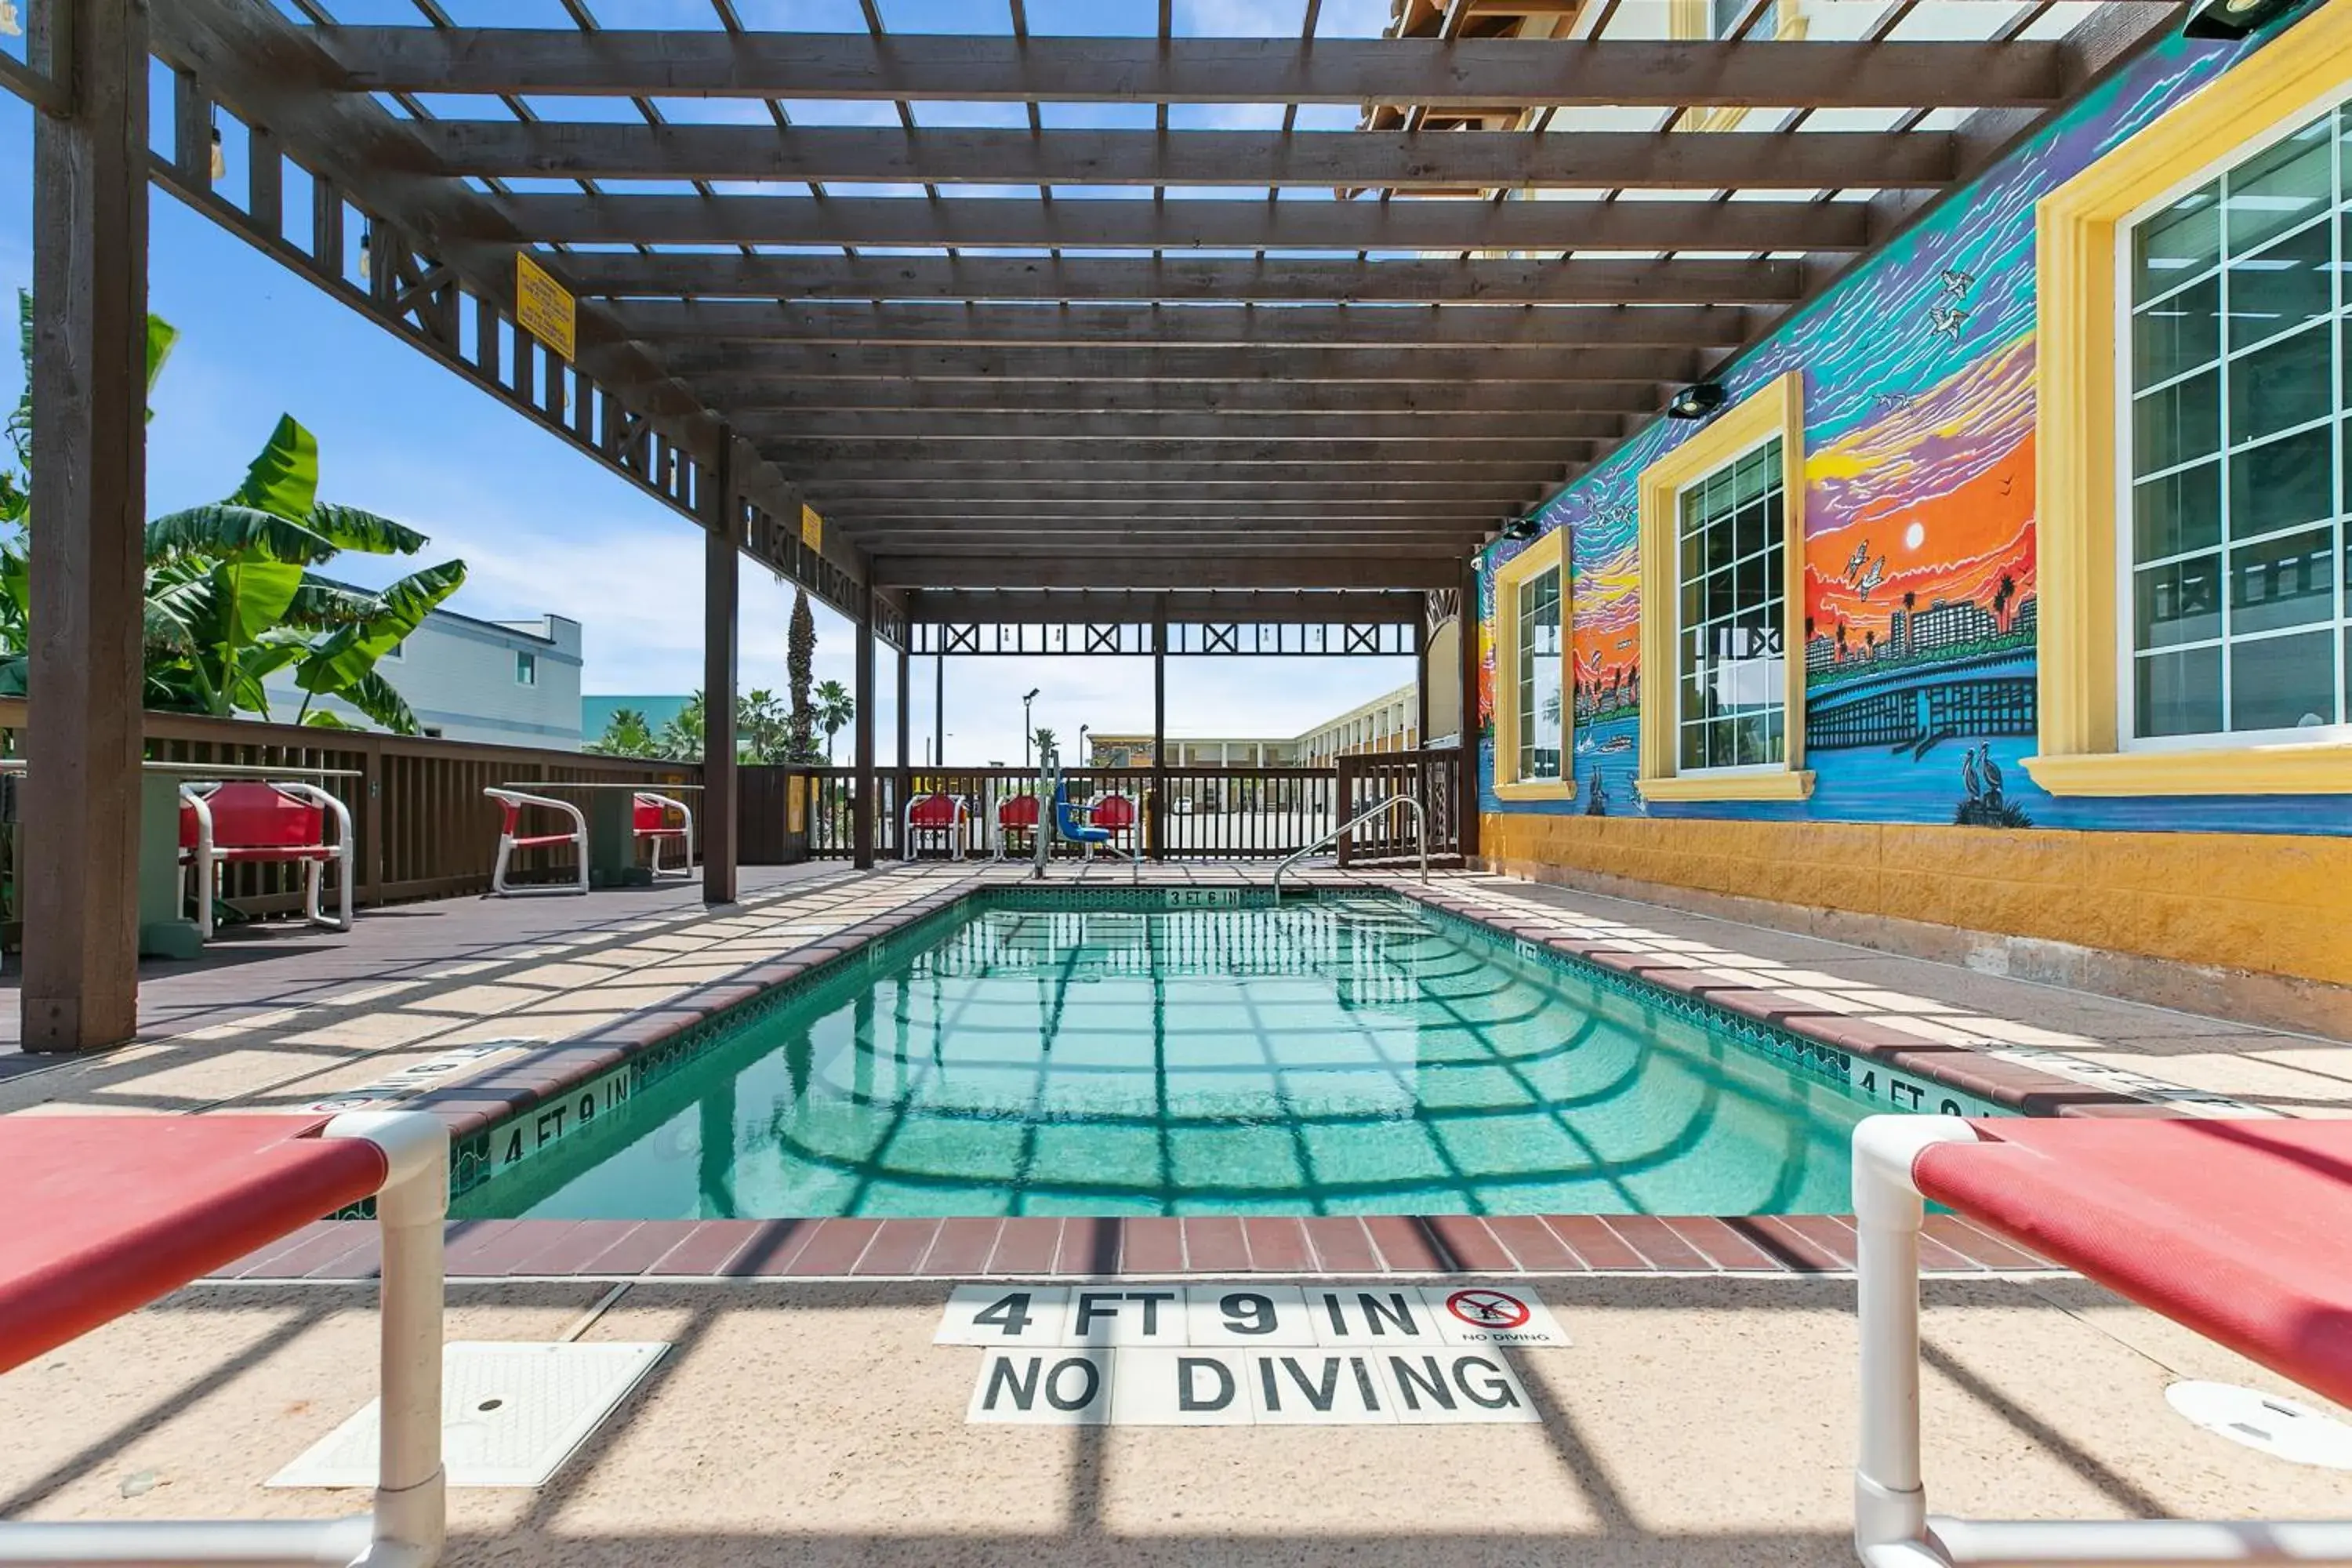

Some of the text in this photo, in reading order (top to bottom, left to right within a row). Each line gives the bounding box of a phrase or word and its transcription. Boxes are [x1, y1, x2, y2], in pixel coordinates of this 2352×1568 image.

[1859, 1071, 1877, 1093] 4
[1892, 1078, 1925, 1110] FT
[504, 1128, 524, 1164] 4
[538, 1105, 566, 1149] FT
[606, 1073, 627, 1109] IN
[974, 1293, 1420, 1335] 4 FT 9 IN
[982, 1356, 1521, 1411] NO DIVING
